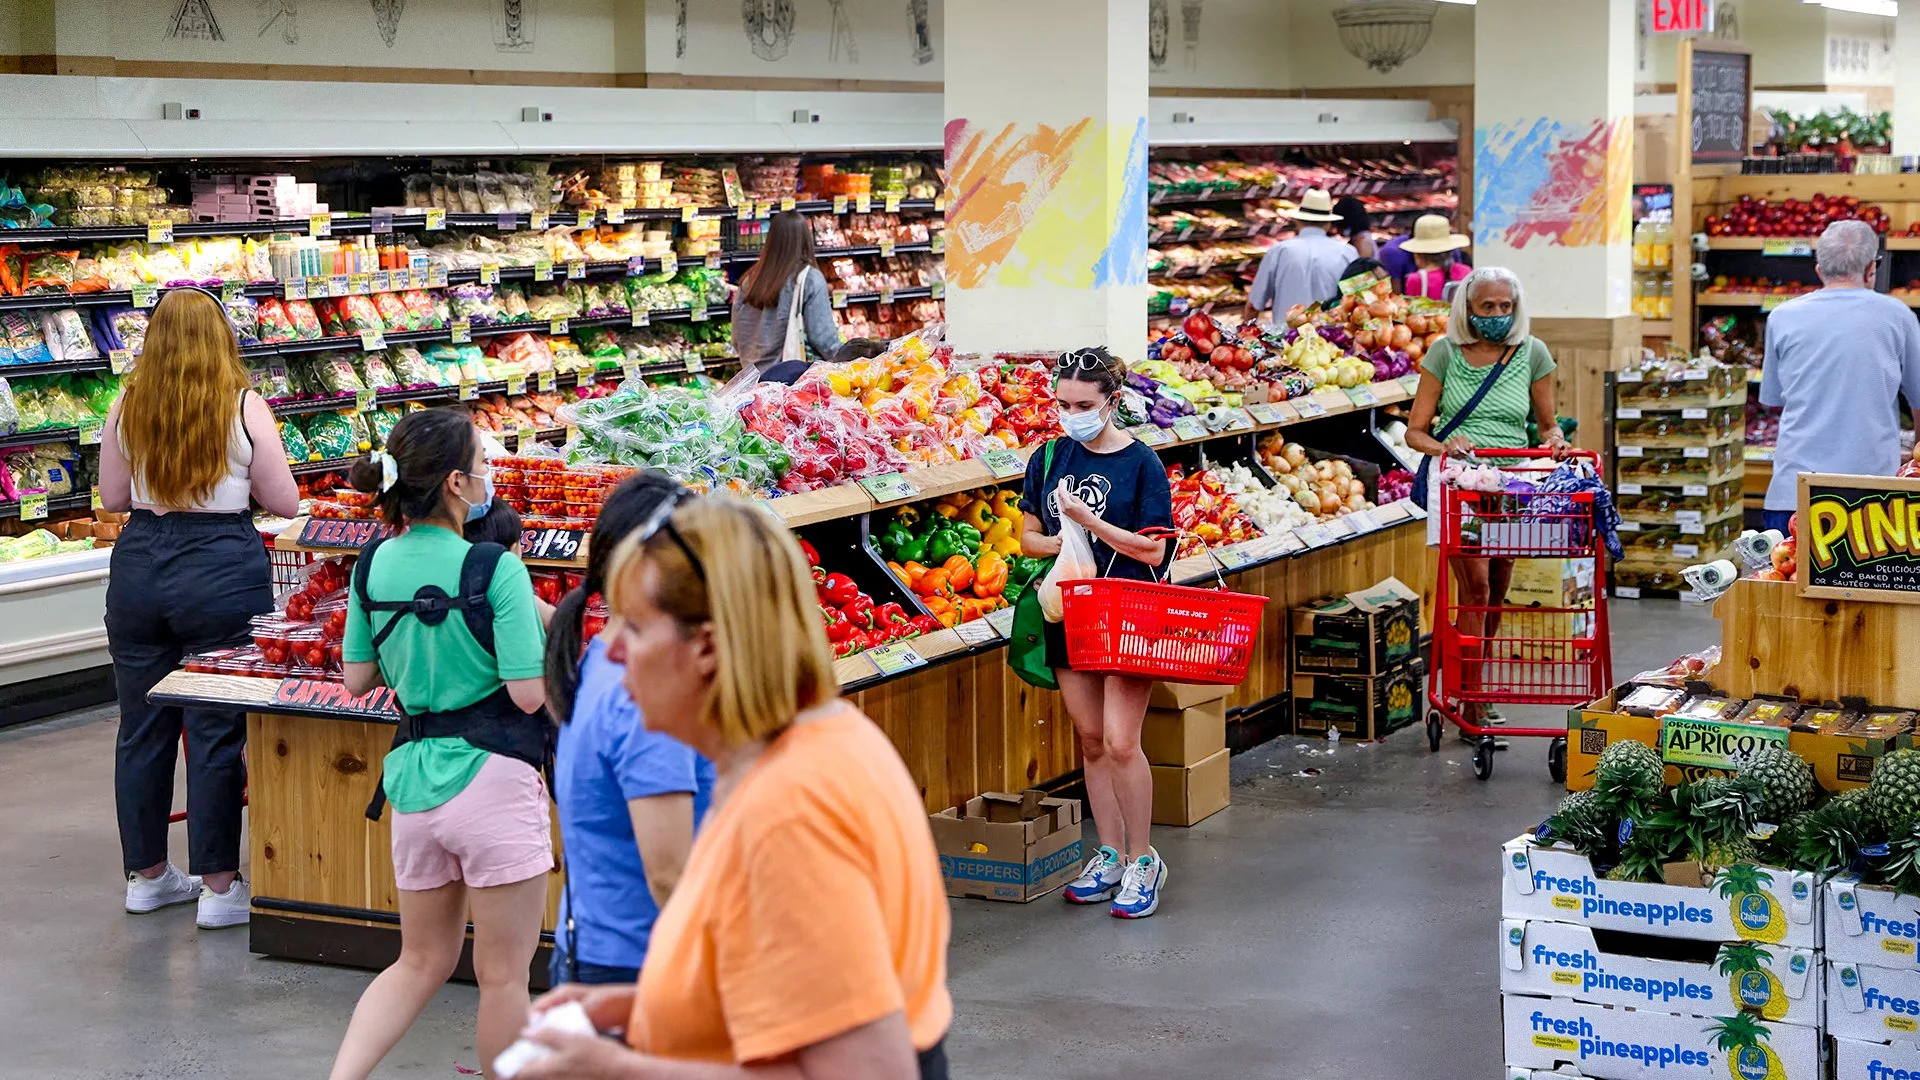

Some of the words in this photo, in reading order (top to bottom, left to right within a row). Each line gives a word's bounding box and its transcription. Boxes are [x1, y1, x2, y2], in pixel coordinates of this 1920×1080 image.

[306, 520, 377, 544] TEENY
[1815, 577, 1827, 585] OR
[1840, 571, 1854, 579] OR
[1858, 573, 1889, 582] BAKED
[1167, 607, 1190, 617] TRADER
[1190, 611, 1208, 619] JOE'S
[873, 647, 890, 656] RED
[278, 680, 386, 709] CAMPARI
[1668, 720, 1721, 733] ORGANIC
[1668, 729, 1785, 758] APRICOTS
[958, 862, 1021, 880] PEPPERS
[1044, 844, 1081, 874] POIVRONS
[1534, 870, 1596, 896] fresh
[1584, 894, 1713, 926] pineapples
[1740, 911, 1770, 925] Chiquita
[1862, 911, 1920, 939] fres
[1533, 945, 1597, 970] fresh
[1584, 969, 1713, 1002] pineapples
[1740, 988, 1770, 1001] Chiquita
[1864, 988, 1920, 1016] fres
[1530, 1011, 1593, 1037] fresh
[1581, 1036, 1709, 1068] pineapples
[1738, 1063, 1768, 1077] Chiquita
